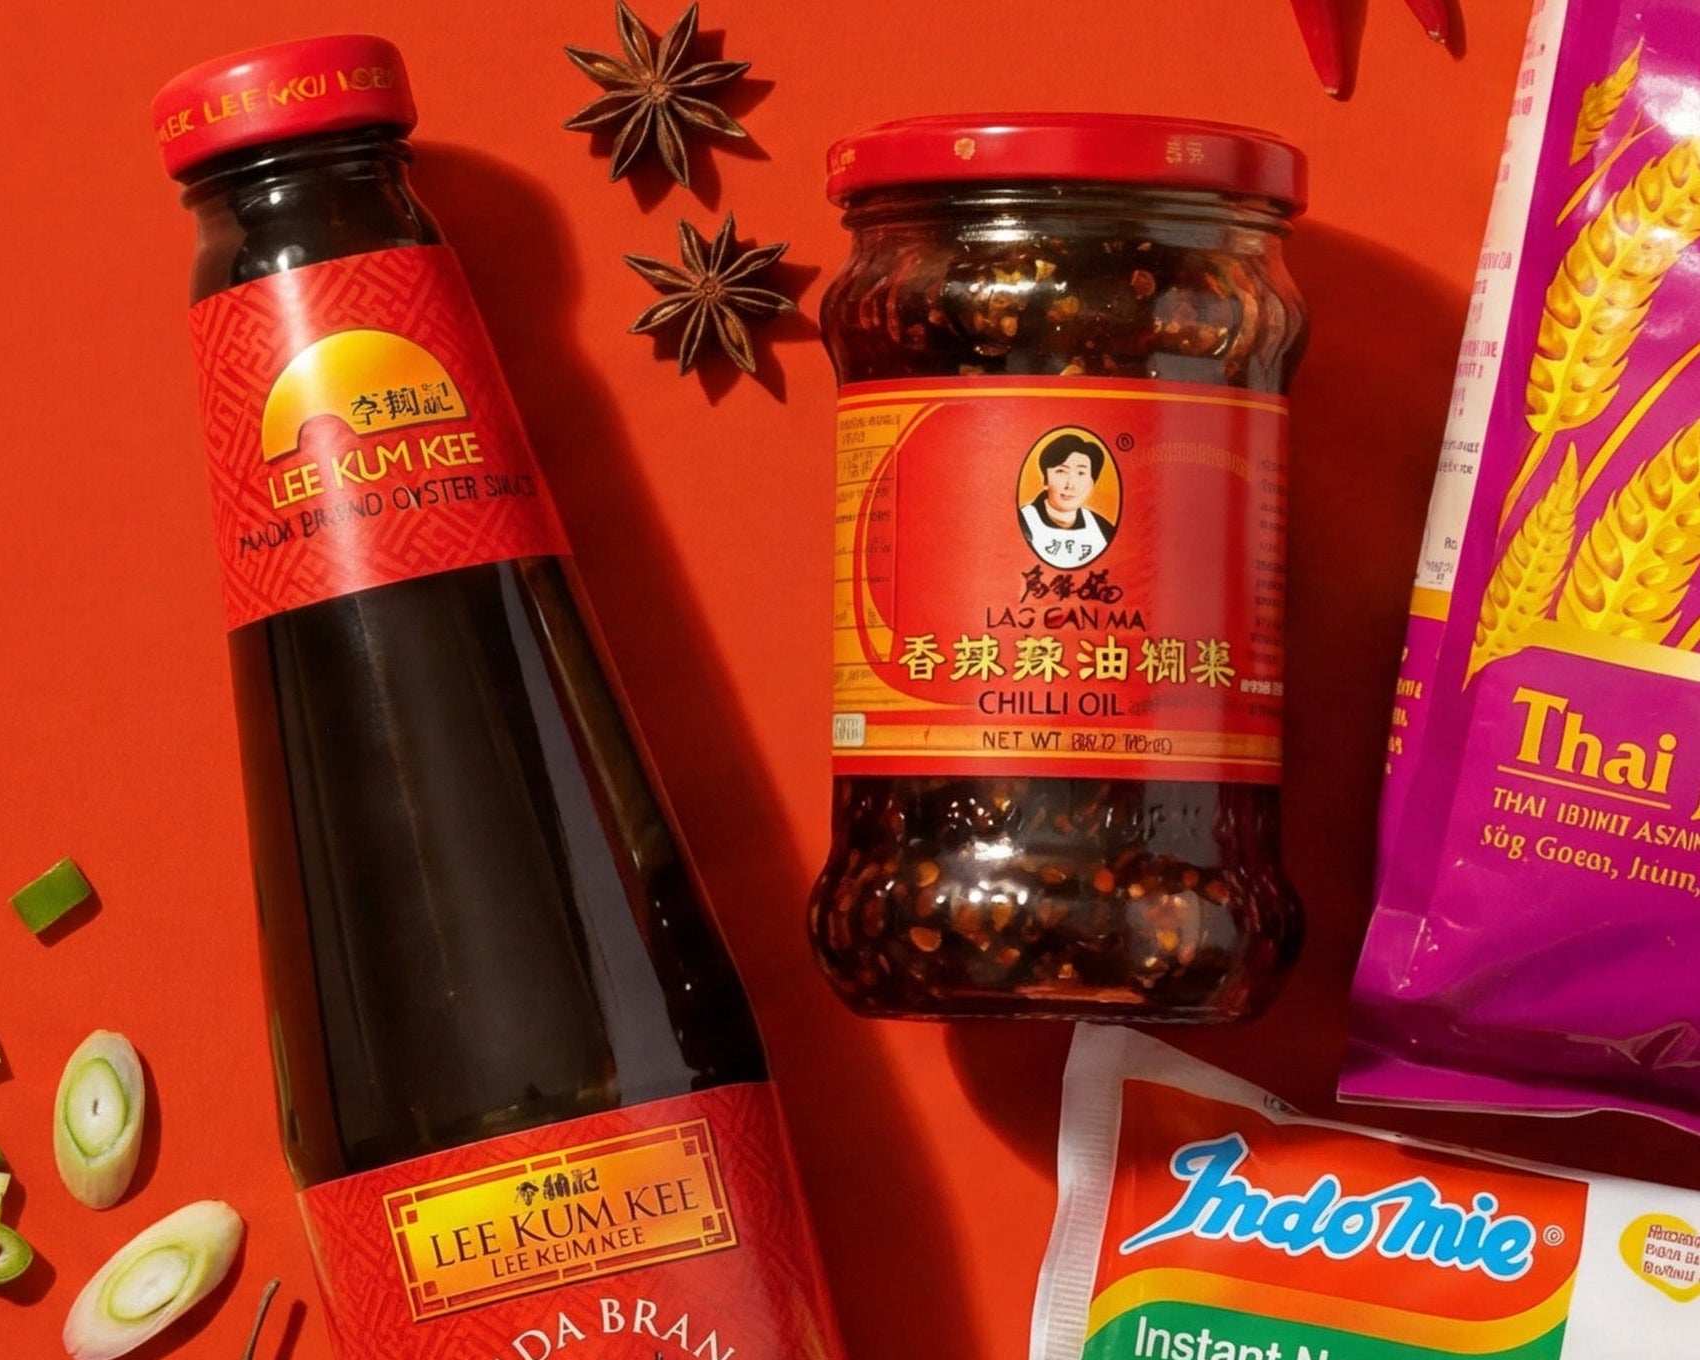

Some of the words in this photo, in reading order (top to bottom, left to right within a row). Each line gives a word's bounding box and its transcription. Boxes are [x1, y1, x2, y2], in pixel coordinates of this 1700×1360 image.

[267, 462, 324, 509] LEE
[331, 440, 413, 489] KUM
[419, 431, 484, 470] KEE
[978, 690, 1069, 715] CHILLI
[1077, 691, 1126, 716] OIL
[982, 730, 1023, 750] NET
[1030, 731, 1063, 750] WT
[1512, 685, 1678, 795] Thai
[1493, 787, 1547, 819] THAI
[430, 1220, 501, 1269] LEE
[510, 1194, 617, 1249] KUM
[623, 1177, 700, 1219] KEE
[491, 1246, 531, 1279] LEE
